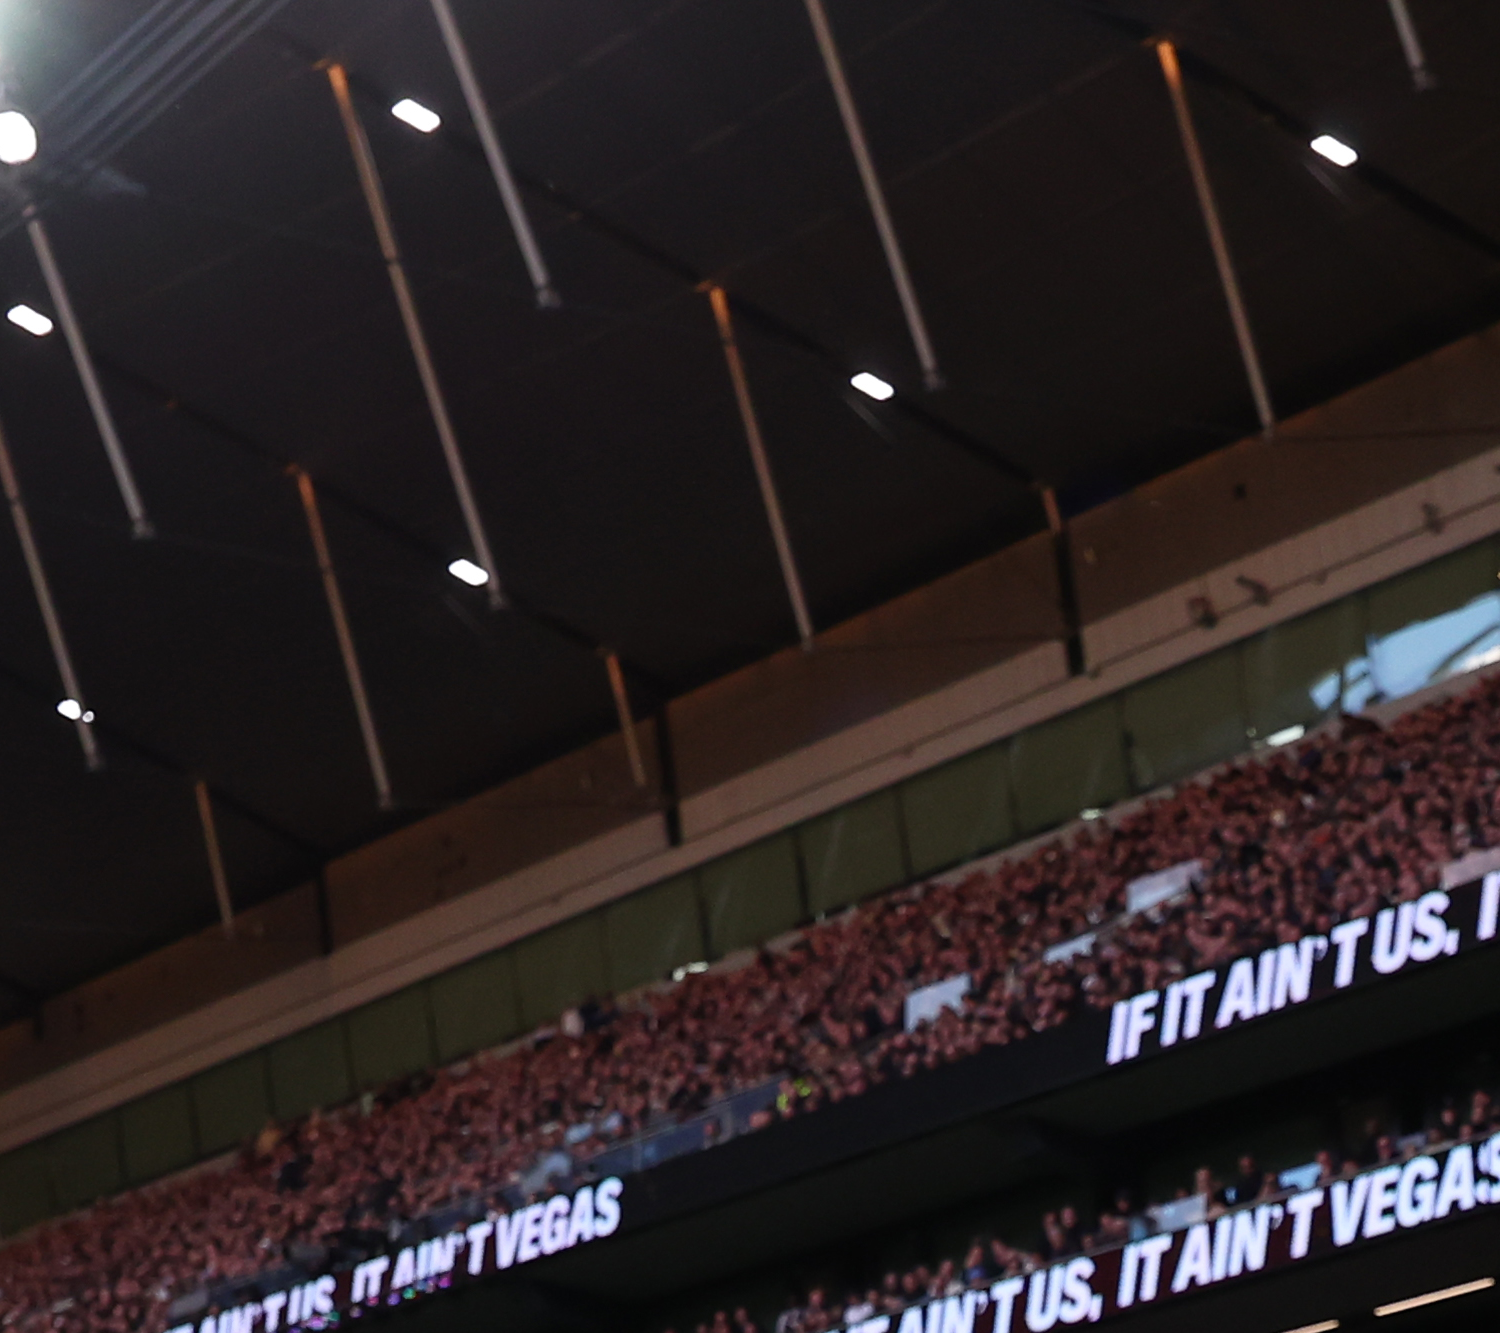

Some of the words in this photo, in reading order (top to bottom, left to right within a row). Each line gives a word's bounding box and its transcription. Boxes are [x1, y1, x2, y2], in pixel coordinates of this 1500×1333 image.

[1107, 992, 1159, 1064] IF
[1161, 972, 1216, 1047] IT
[1216, 918, 1369, 1028] AIN'T
[1117, 1234, 1173, 1308] IT
[1172, 1189, 1325, 1293] AIN'T
